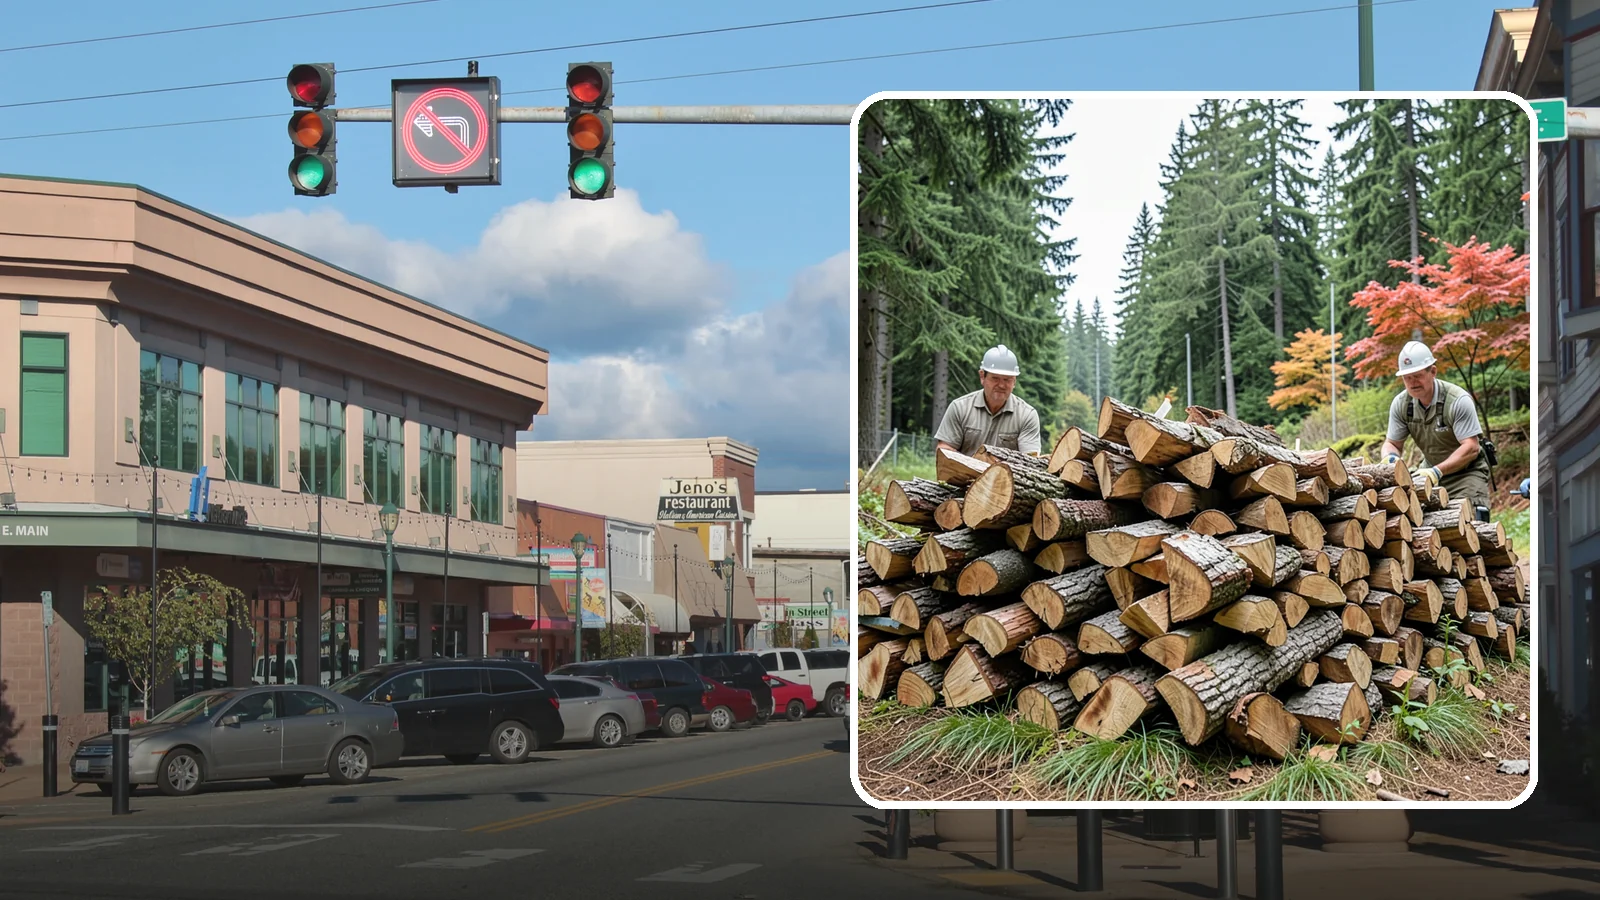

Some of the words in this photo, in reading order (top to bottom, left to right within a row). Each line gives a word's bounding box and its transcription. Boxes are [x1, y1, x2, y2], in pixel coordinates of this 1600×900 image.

[670, 480, 728, 495] Jeno's
[665, 496, 731, 509] restaurant
[658, 510, 682, 520] Italian
[685, 509, 715, 520] American
[714, 510, 737, 519] Cuisine
[2, 525, 13, 536] E.
[15, 525, 49, 536] MAIN
[797, 608, 828, 616] Street
